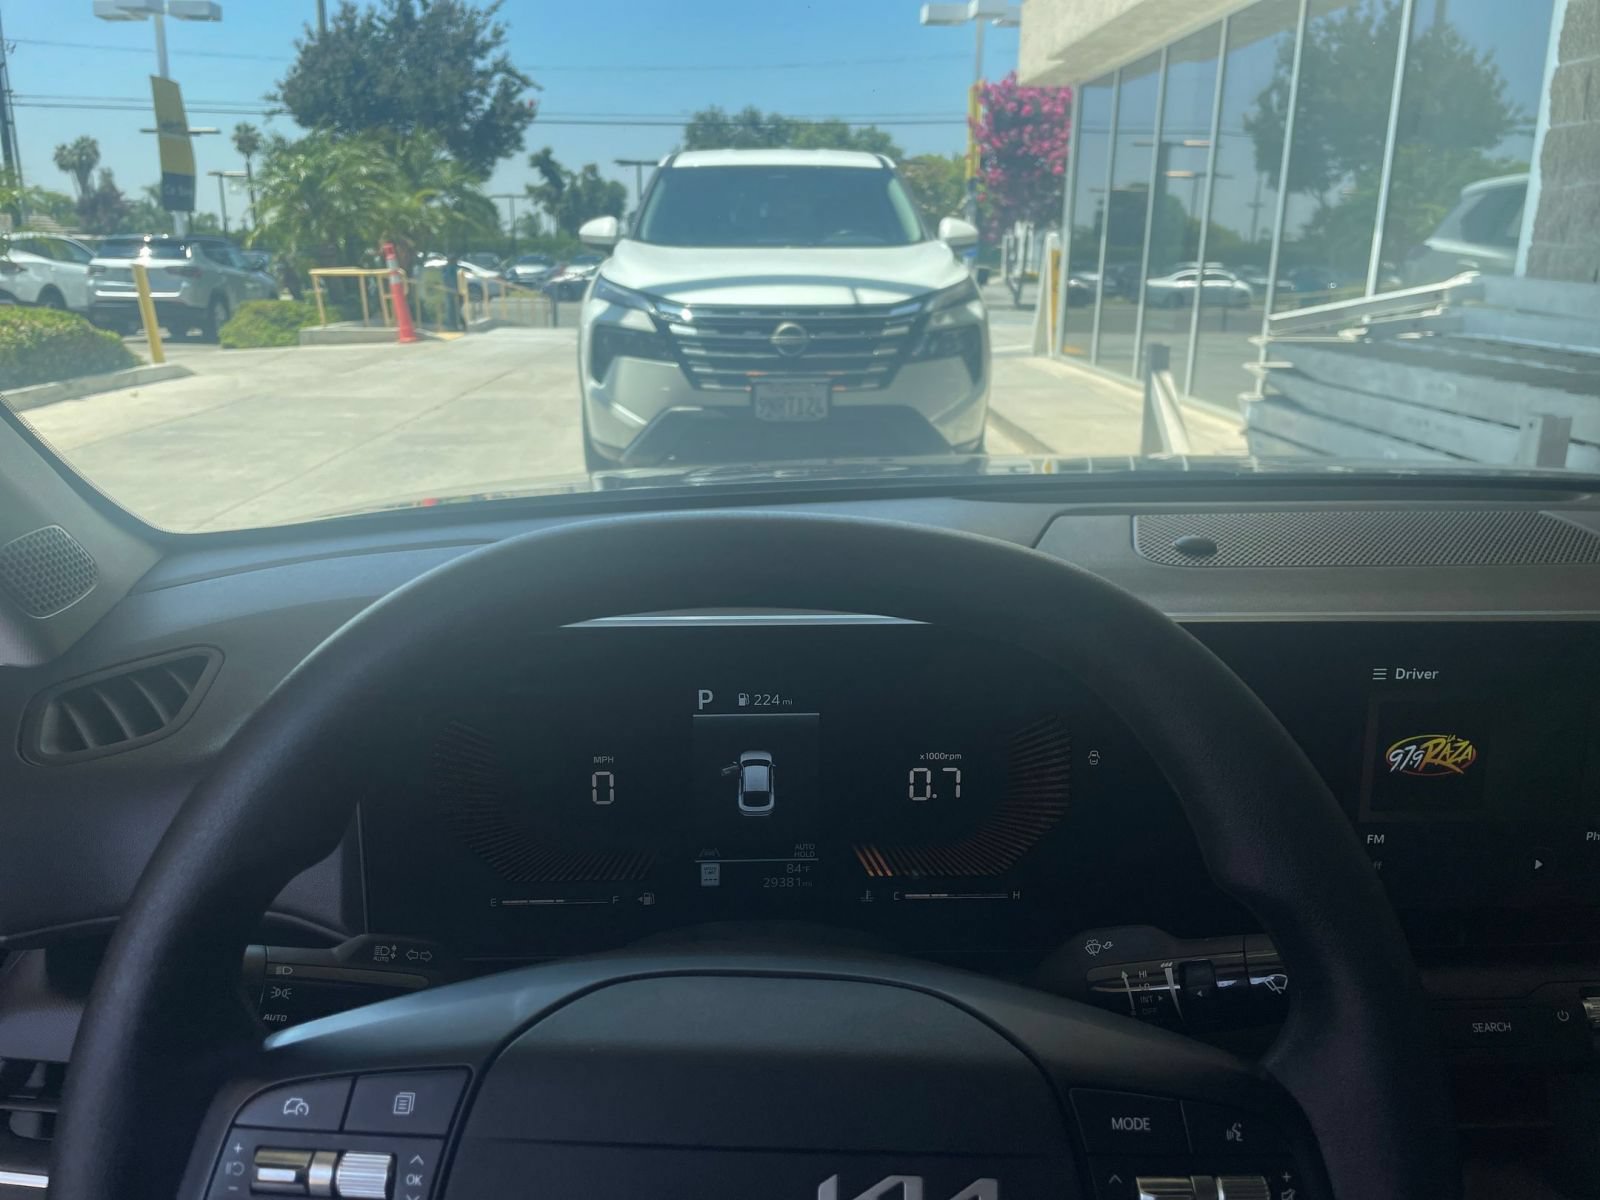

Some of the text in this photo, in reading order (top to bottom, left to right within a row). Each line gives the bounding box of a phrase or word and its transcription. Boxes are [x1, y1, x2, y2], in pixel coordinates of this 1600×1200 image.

[1395, 667, 1439, 680] Driver
[698, 688, 714, 710] P
[753, 694, 780, 706] 224
[592, 755, 614, 765] MPH
[919, 751, 962, 761] x1000rpm
[1389, 737, 1474, 775] 97.9 RAZA
[591, 771, 615, 805] 0
[908, 767, 961, 801] 0.7
[1367, 834, 1385, 845] FM
[793, 850, 816, 858] HOLD
[762, 877, 801, 888] 29381
[612, 895, 619, 905] F
[1012, 890, 1021, 900] H
[490, 898, 497, 907] E
[1138, 970, 1148, 978] HI
[263, 1013, 288, 1022] AUTO
[1471, 1022, 1512, 1033] SEARCH
[1111, 1116, 1151, 1132] MODE
[405, 1174, 422, 1187] OK
